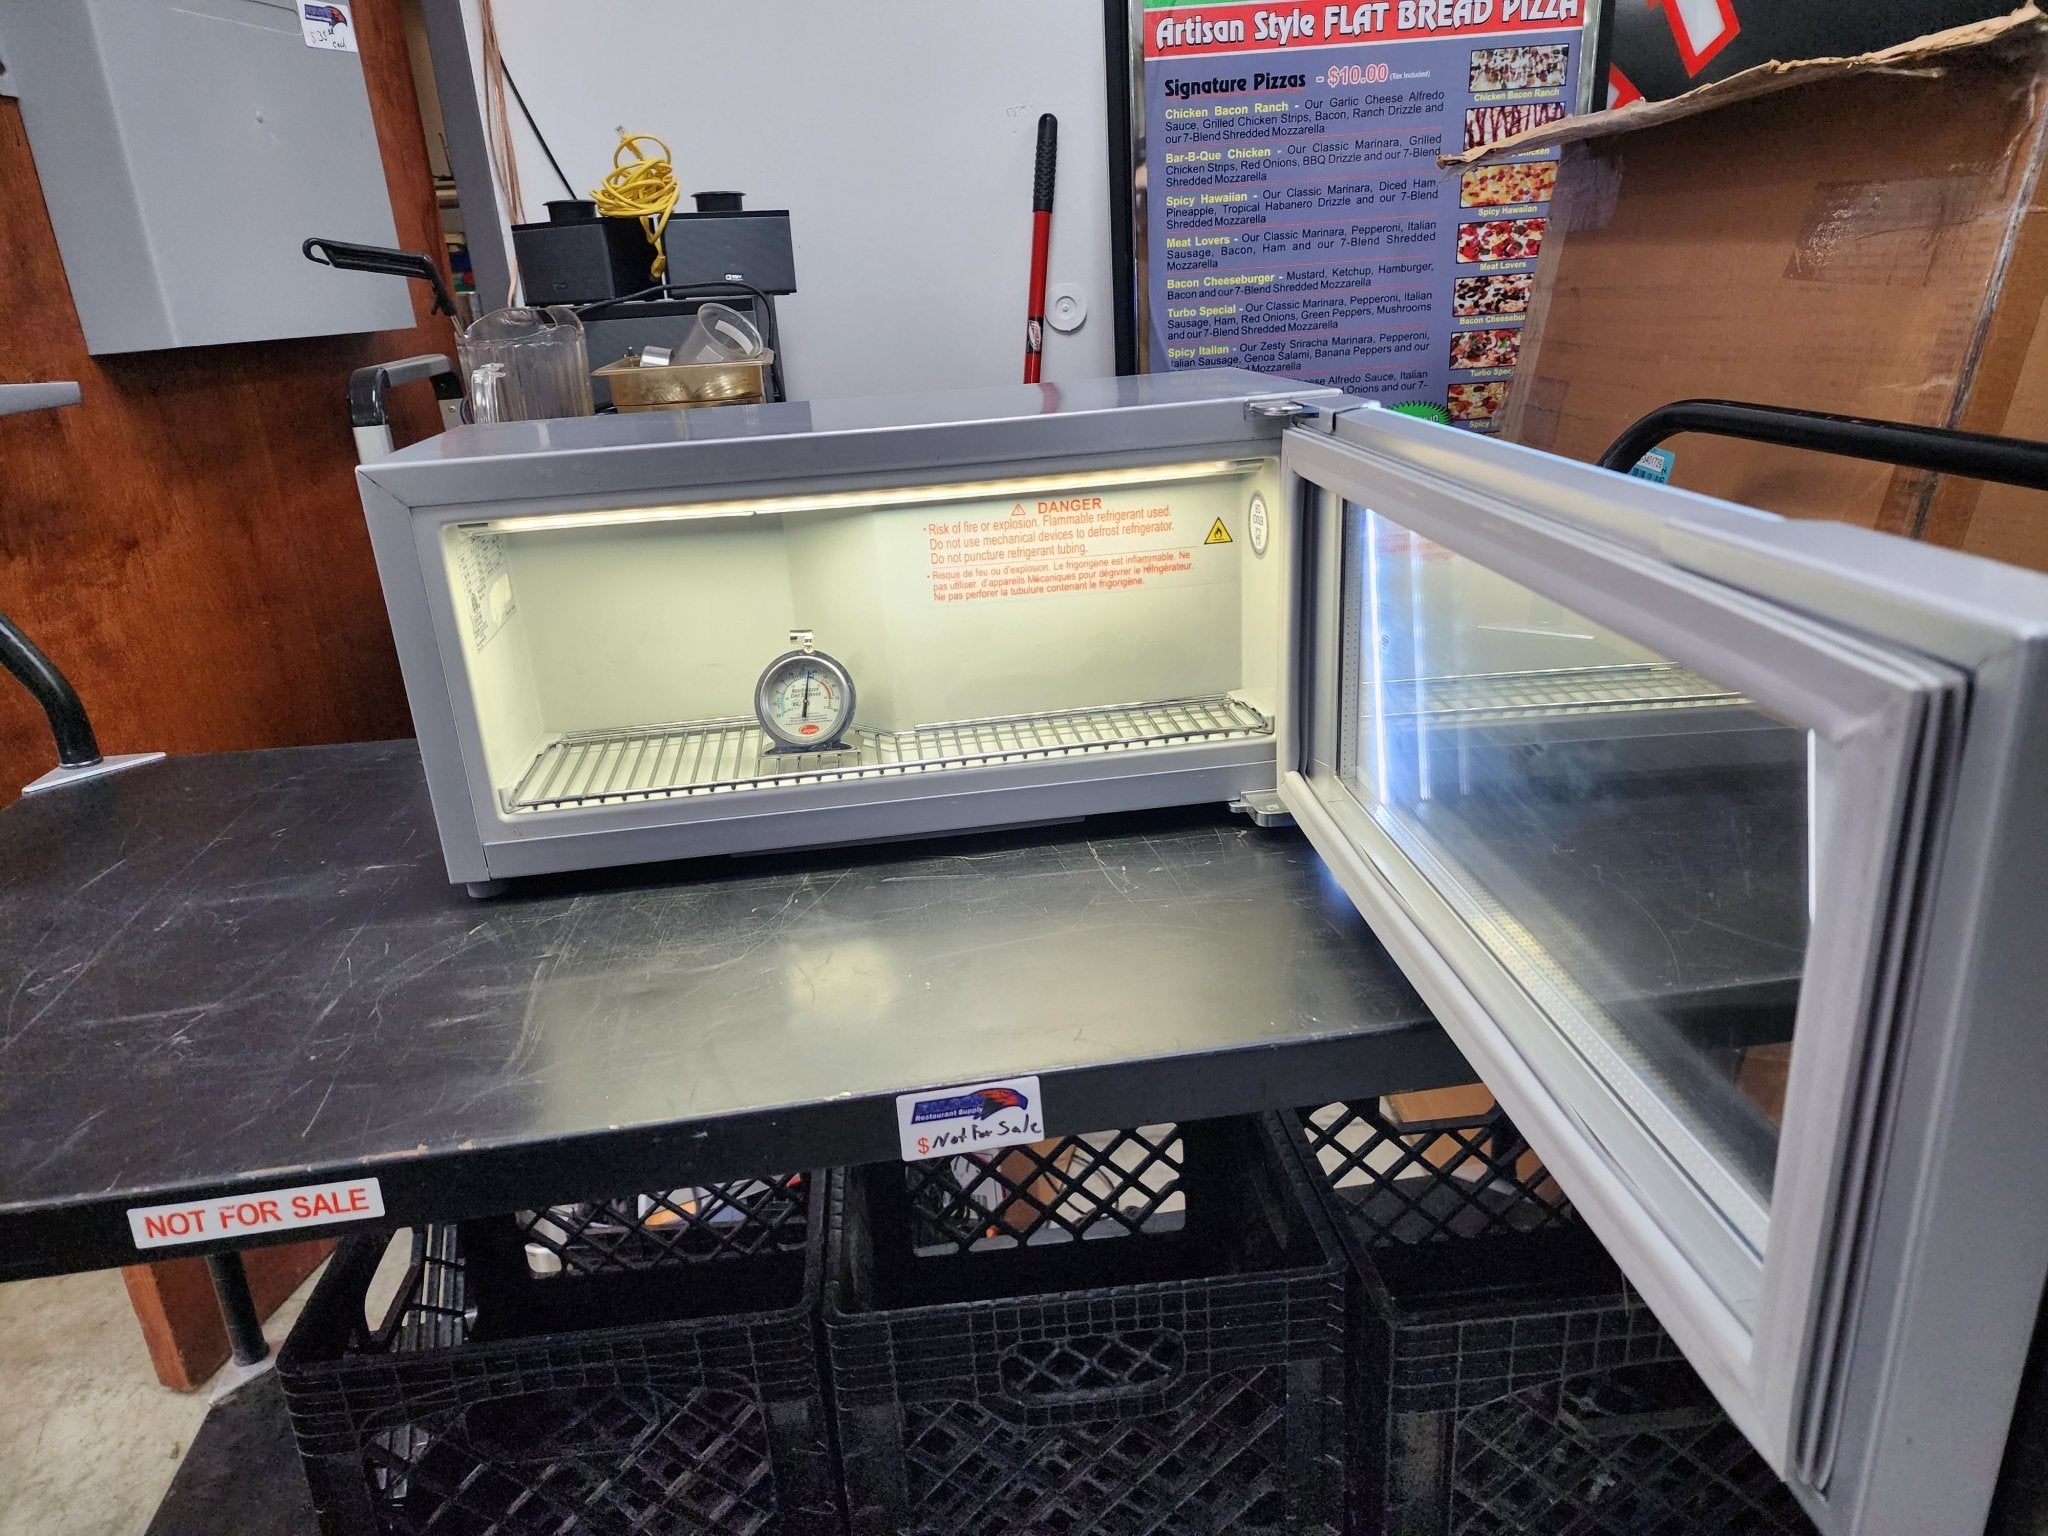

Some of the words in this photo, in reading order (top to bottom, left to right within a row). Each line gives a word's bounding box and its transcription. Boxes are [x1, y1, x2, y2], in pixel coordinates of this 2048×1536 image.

[1156, 15, 1245, 51] Artisan
[1254, 8, 1315, 45] Style
[1324, 2, 1390, 39] FLAT
[1397, 0, 1494, 31] BREAD
[1502, 0, 1578, 23] PIZZA
[1164, 77, 1247, 100] Signature
[1253, 72, 1306, 91] Pizzas
[1327, 63, 1388, 87] $10.00
[1403, 70, 1431, 79] Included)
[1474, 91, 1506, 102] Chicken
[1507, 90, 1533, 99] Bacon
[1534, 87, 1560, 97] Ranch
[1165, 107, 1208, 119] Chicken
[1214, 105, 1248, 116] Bacon
[1254, 101, 1289, 113] Ranch
[1304, 99, 1324, 109] Our
[1329, 96, 1359, 107] Garlic
[1364, 94, 1404, 105] Cheese
[1408, 90, 1445, 101] Alfredo
[1165, 122, 1199, 131] Sauce,
[1202, 117, 1234, 129] Grilled
[1237, 115, 1278, 126] Chicken
[1280, 113, 1312, 124] Strips,
[1315, 111, 1349, 121] Bacon,
[1352, 106, 1385, 118] Ranch
[1388, 104, 1422, 115] Drizzle
[1425, 102, 1444, 113] and
[1165, 135, 1181, 144] our
[1183, 130, 1220, 142] 7-Blend
[1222, 127, 1270, 140] Shredded
[1271, 124, 1325, 136] Mozzarella
[1165, 151, 1222, 163] Bar-B-Que
[1227, 147, 1271, 159] Chicken
[1287, 144, 1306, 154] Our
[1312, 141, 1349, 153] Classic
[1408, 134, 1442, 146] Grilled
[1165, 164, 1205, 175] Chicken
[1207, 162, 1238, 173] Strips,
[1240, 159, 1260, 170] Red
[1262, 158, 1300, 168] Onions,
[1302, 154, 1326, 165] BBQ
[1328, 152, 1362, 163] Drizzle
[1363, 150, 1382, 161] and
[1384, 151, 1401, 159] our
[1403, 146, 1441, 158] 7-Blend
[1166, 195, 1195, 208] Spicy
[1200, 192, 1248, 203] Hawaiian
[1379, 180, 1407, 191] Diced
[1166, 205, 1217, 218] Pineapple,
[1222, 201, 1260, 215] Tropical
[1265, 200, 1313, 210] Habanero
[1317, 195, 1351, 207] Drizzle
[1478, 206, 1501, 217] Spicy
[1501, 203, 1538, 214] Hawaiian
[1166, 237, 1192, 248] Meat
[1195, 236, 1230, 246] Lovers
[1351, 222, 1403, 236] Pepperoni,
[1407, 221, 1437, 231] Italian
[1166, 249, 1215, 259] Sausage,
[1221, 246, 1256, 255] Bacon,
[1262, 243, 1286, 252] Ham
[1386, 231, 1436, 244] Shredded
[1166, 279, 1199, 288] Bacon
[1203, 274, 1276, 286] Cheeseburger
[1286, 268, 1328, 280] Mustard,
[1332, 266, 1374, 277] Ketchup,
[1378, 262, 1434, 274] Hamburger,
[1479, 261, 1499, 271] Meat
[1500, 260, 1527, 269] Lovers
[1167, 307, 1197, 318] Turbo
[1199, 304, 1236, 317] Special
[1300, 310, 1330, 319] Green
[1332, 308, 1374, 318] Peppers,
[1376, 303, 1432, 314] Mushrooms
[1459, 316, 1484, 325] Bacon
[1168, 347, 1196, 359] Spicy
[1199, 345, 1229, 355] Italian
[1239, 343, 1258, 352] Our
[1260, 340, 1286, 351] Zesty
[1379, 330, 1430, 343] Pepperoni,
[1197, 356, 1241, 366] Sausage,
[1244, 353, 1275, 363] Genoa
[1277, 349, 1312, 360] Salami,
[1314, 348, 1351, 358] Banana
[1353, 345, 1392, 356] Peppers
[1328, 373, 1361, 384] Alfredo
[1364, 372, 1397, 382] Sauce,
[1400, 369, 1428, 379] Italian
[1346, 384, 1380, 394] Onions
[1038, 497, 1102, 514] DANGER
[928, 522, 949, 536] Risk
[951, 521, 962, 534] of
[963, 520, 979, 533] fire
[980, 522, 990, 531] or
[992, 516, 1039, 532] explosion.
[1042, 511, 1094, 526] Flammable
[1096, 507, 1144, 524] refrigerant
[1146, 505, 1172, 518] used.
[929, 538, 944, 550] Do
[946, 536, 961, 549] not
[963, 537, 980, 548] use
[982, 530, 1036, 546] mechanical
[1038, 528, 1074, 542] devices
[1076, 526, 1085, 539] to
[1087, 523, 1120, 537] defrost
[1121, 519, 1174, 536] refrigerator.
[930, 552, 945, 564] Do
[947, 550, 962, 563] not
[964, 548, 1005, 565] puncture
[1057, 542, 1088, 556] tubing.
[915, 1109, 957, 1122] Restaurant
[917, 1136, 929, 1155] $
[932, 1127, 967, 1149] Not
[997, 1114, 1042, 1136] Sale
[144, 1209, 206, 1239] NOT
[218, 1200, 282, 1229] FOR
[292, 1188, 370, 1218] SALE
